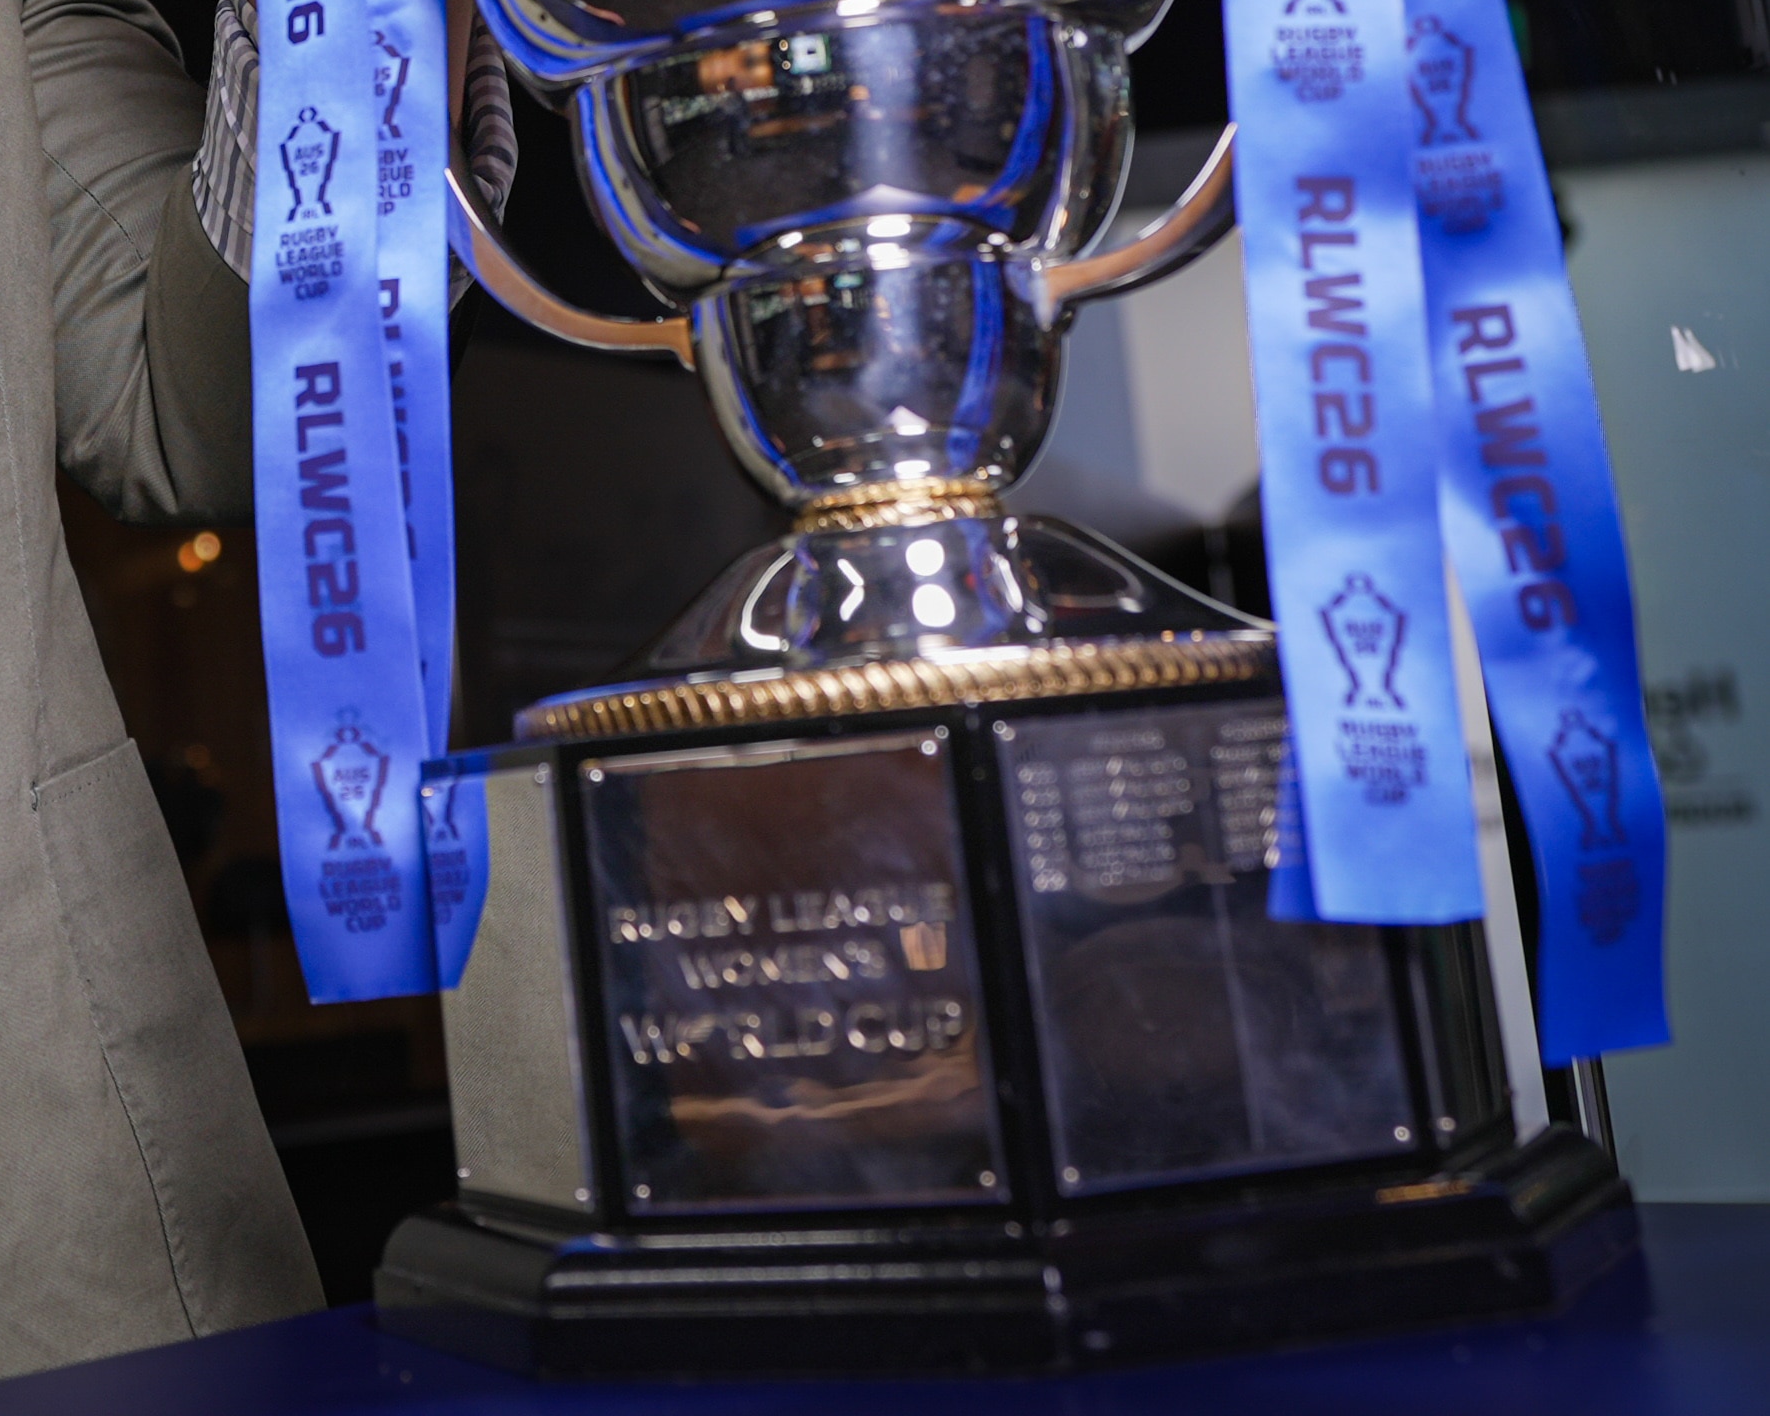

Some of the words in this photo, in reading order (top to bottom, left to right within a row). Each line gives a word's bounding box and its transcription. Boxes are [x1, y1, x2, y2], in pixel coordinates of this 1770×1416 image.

[280, 224, 339, 247] RUGBY
[275, 241, 344, 268] LEAGUE
[278, 260, 343, 285] WORLD
[294, 280, 329, 301] CUP
[1296, 176, 1379, 496] RLWC26
[1452, 304, 1578, 631] RLWC26
[295, 361, 366, 658] RLWC26
